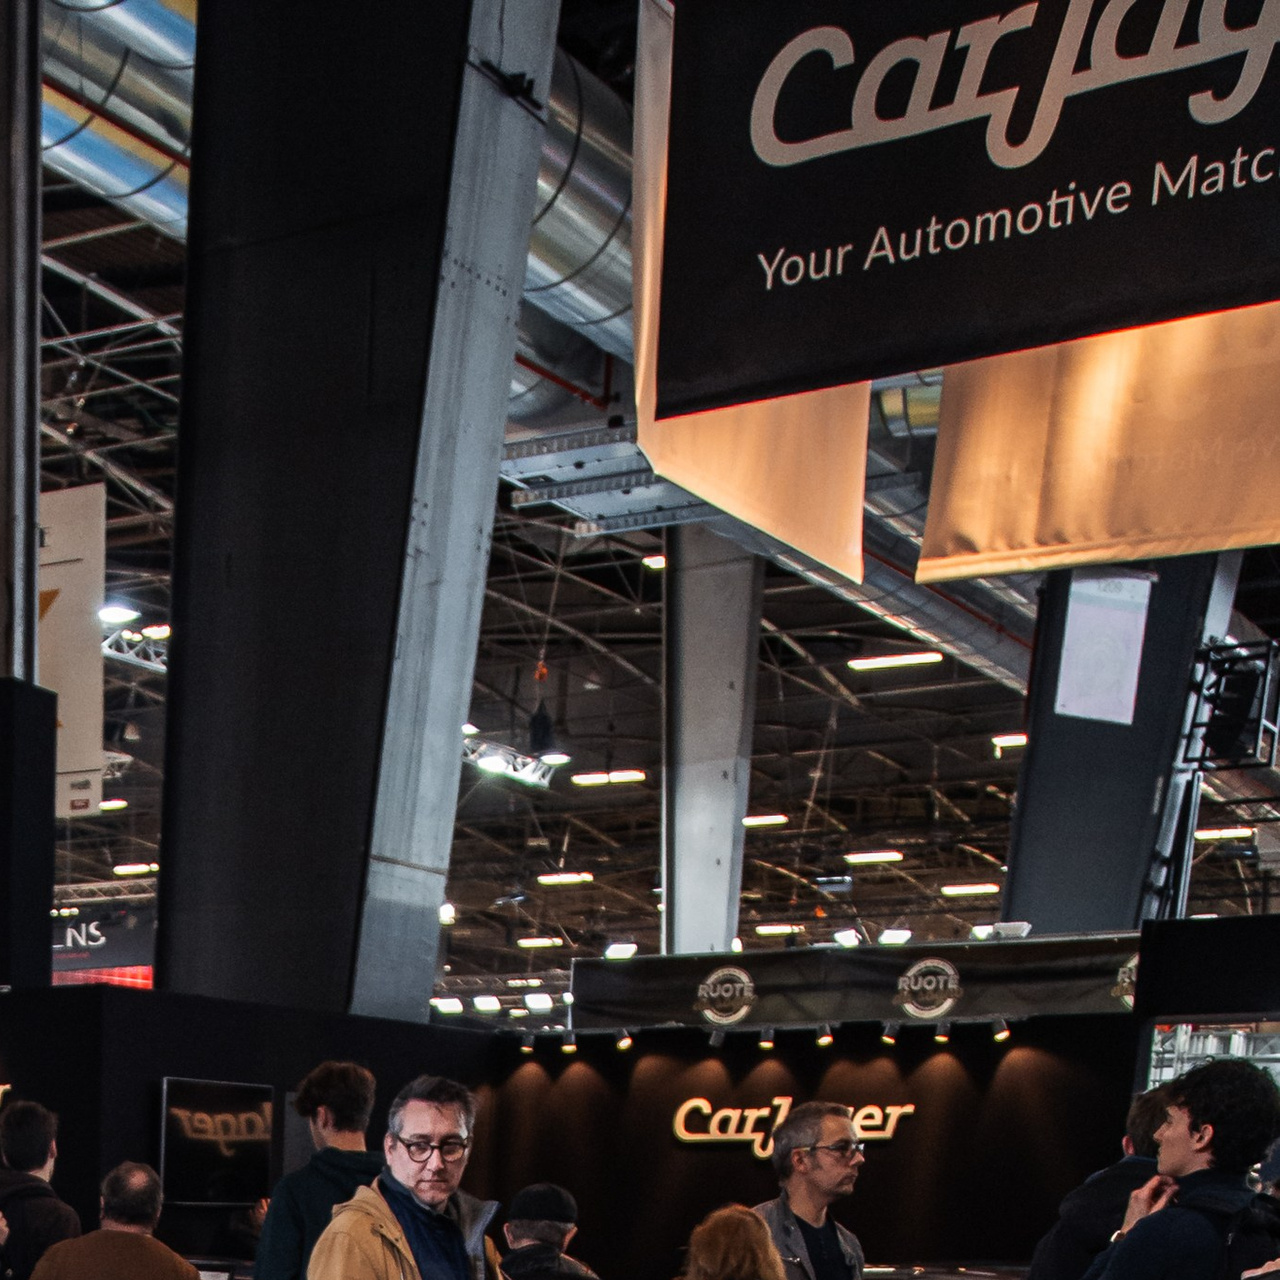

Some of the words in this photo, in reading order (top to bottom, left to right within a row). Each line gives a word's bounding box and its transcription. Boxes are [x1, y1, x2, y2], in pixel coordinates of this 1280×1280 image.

[758, 243, 852, 290] Your
[863, 180, 1131, 270] Automotive
[1151, 146, 1280, 205] Matc
[52, 921, 106, 948] NS
[698, 982, 755, 999] RUOTE
[897, 974, 961, 993] RUOTE
[674, 1097, 915, 1160] CarJer
